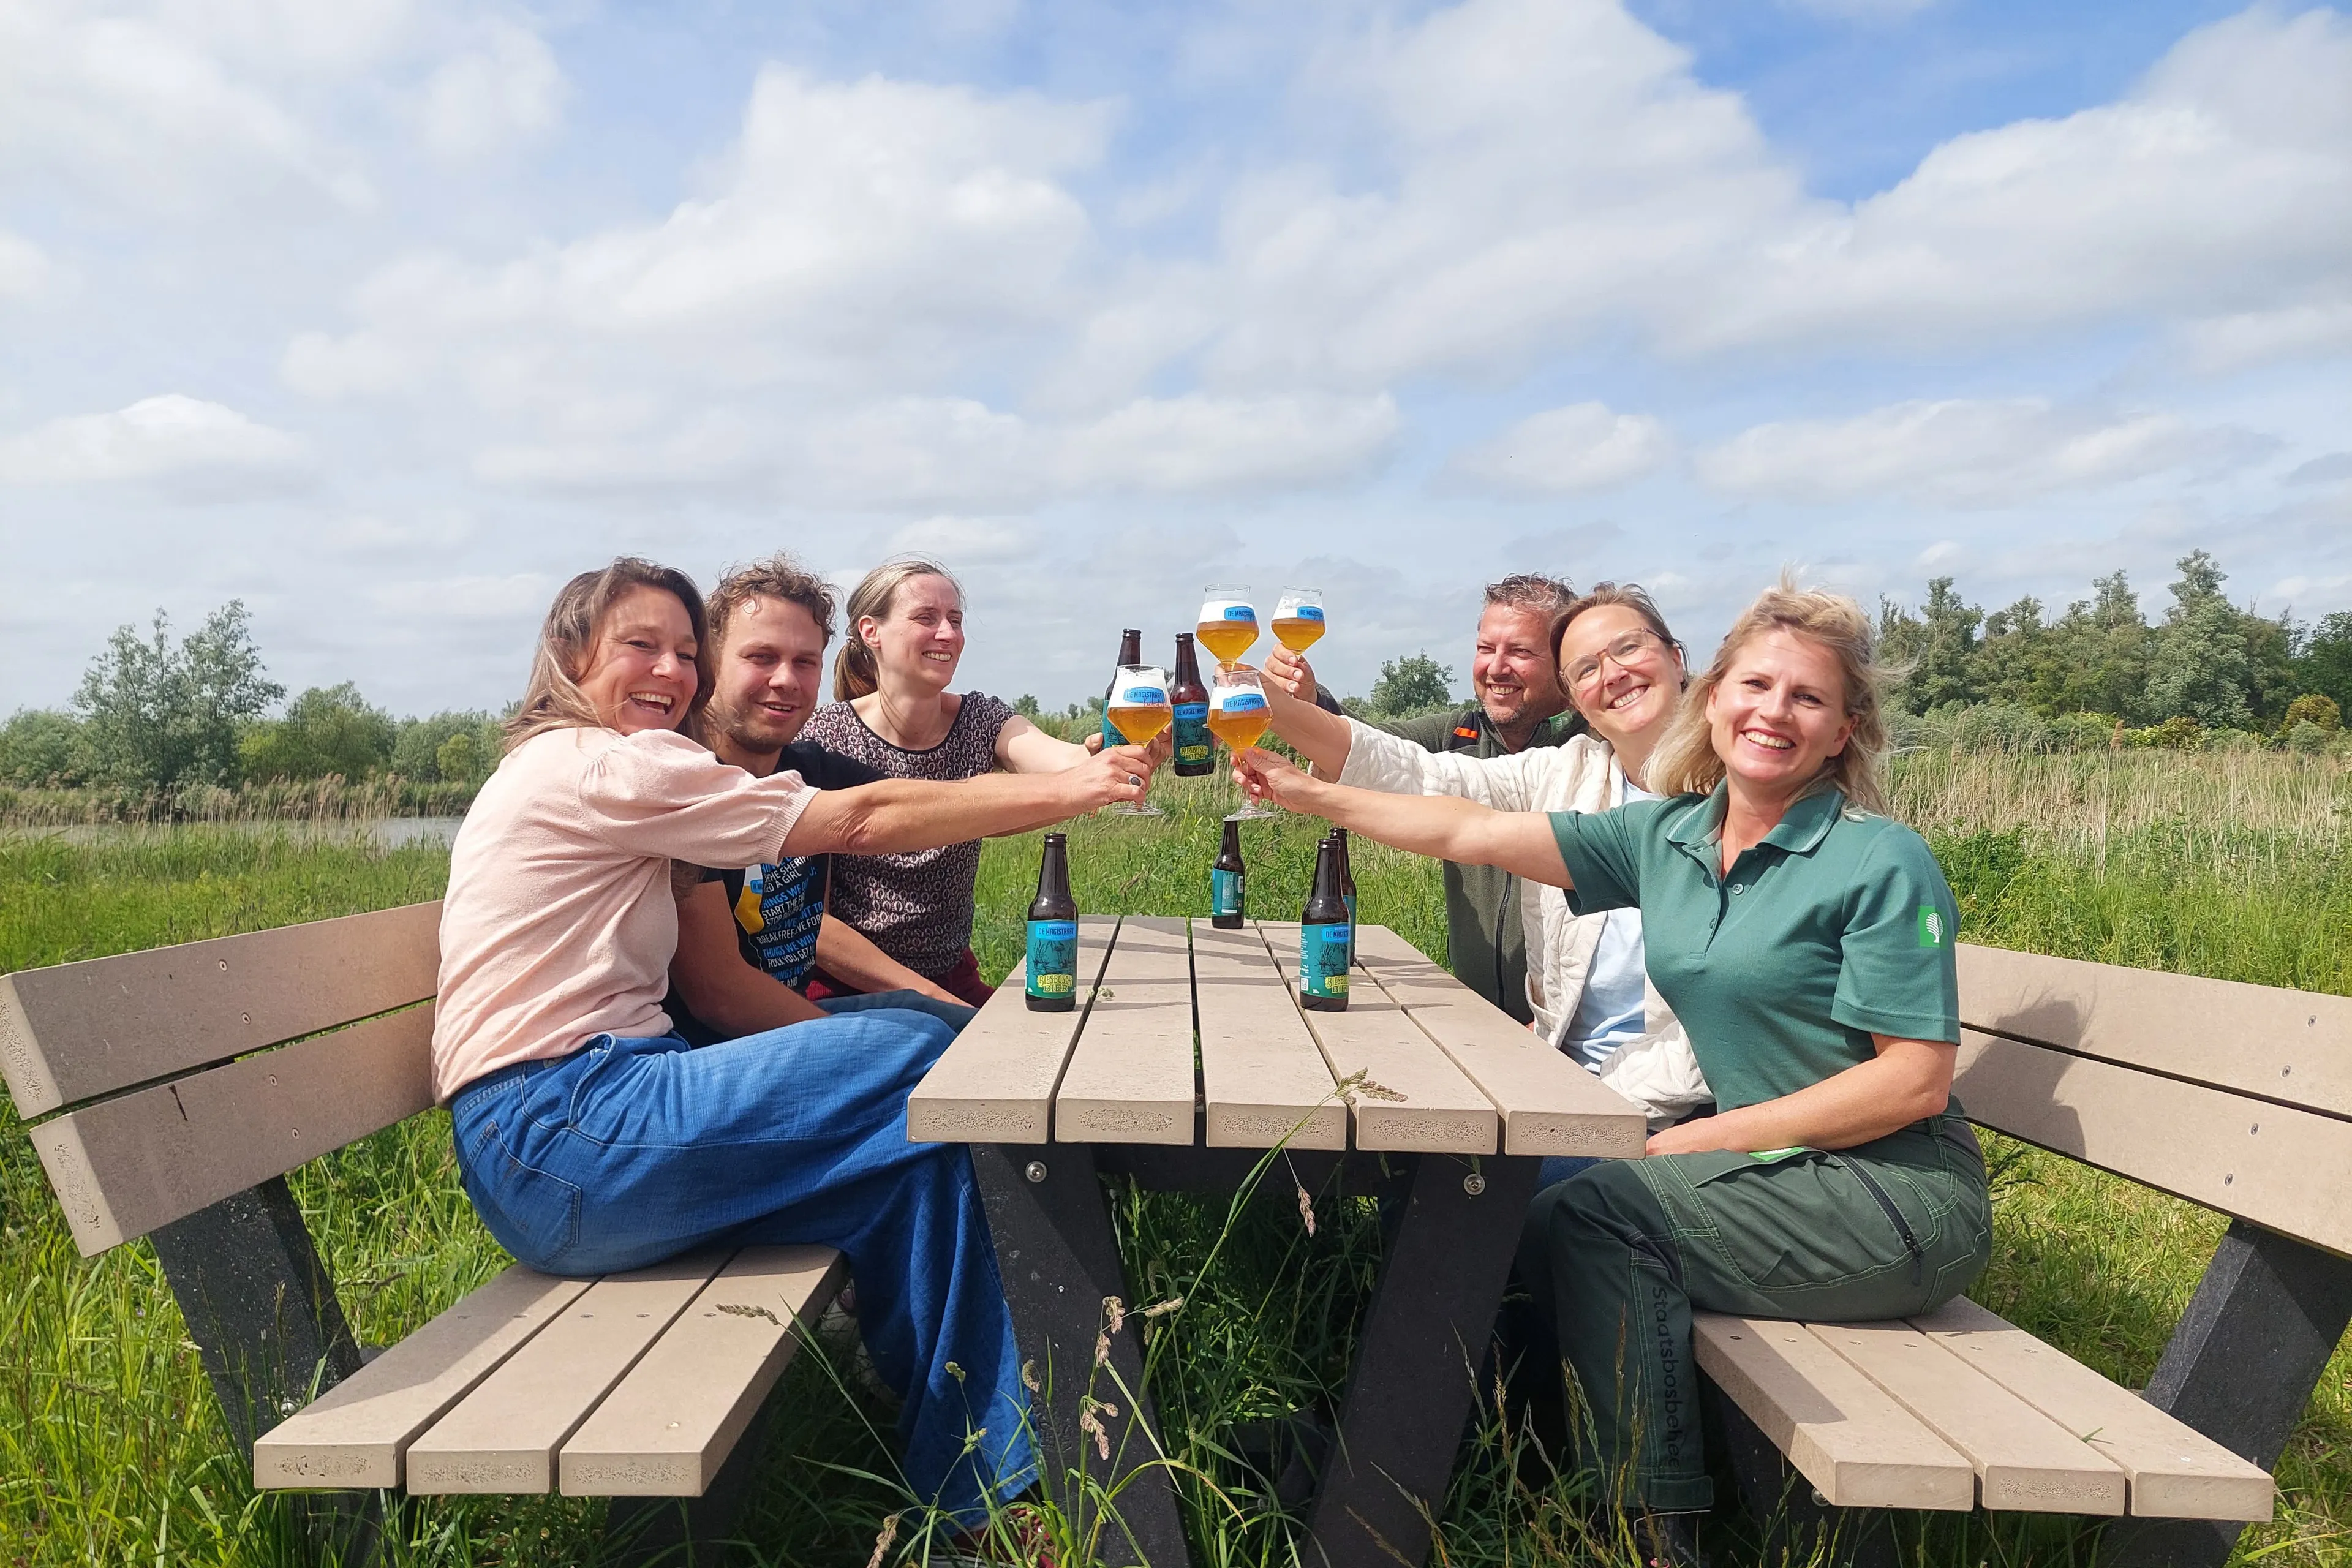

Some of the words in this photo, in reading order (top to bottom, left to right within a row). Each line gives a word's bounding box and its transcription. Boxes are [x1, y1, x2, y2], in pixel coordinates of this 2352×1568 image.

[775, 880, 783, 889] A
[782, 869, 802, 884] GIRL
[786, 884, 801, 898] WE
[762, 903, 786, 919] START
[812, 901, 823, 913] TO
[756, 932, 778, 944] BREAK
[762, 944, 786, 959] THINGS
[784, 941, 799, 954] WE
[767, 957, 785, 968] ROCK
[782, 953, 800, 963] YOU,
[786, 976, 798, 988] AND
[1038, 974, 1072, 987] BIESBOSCH
[1653, 1287, 1683, 1468] Staatsbosbehee
